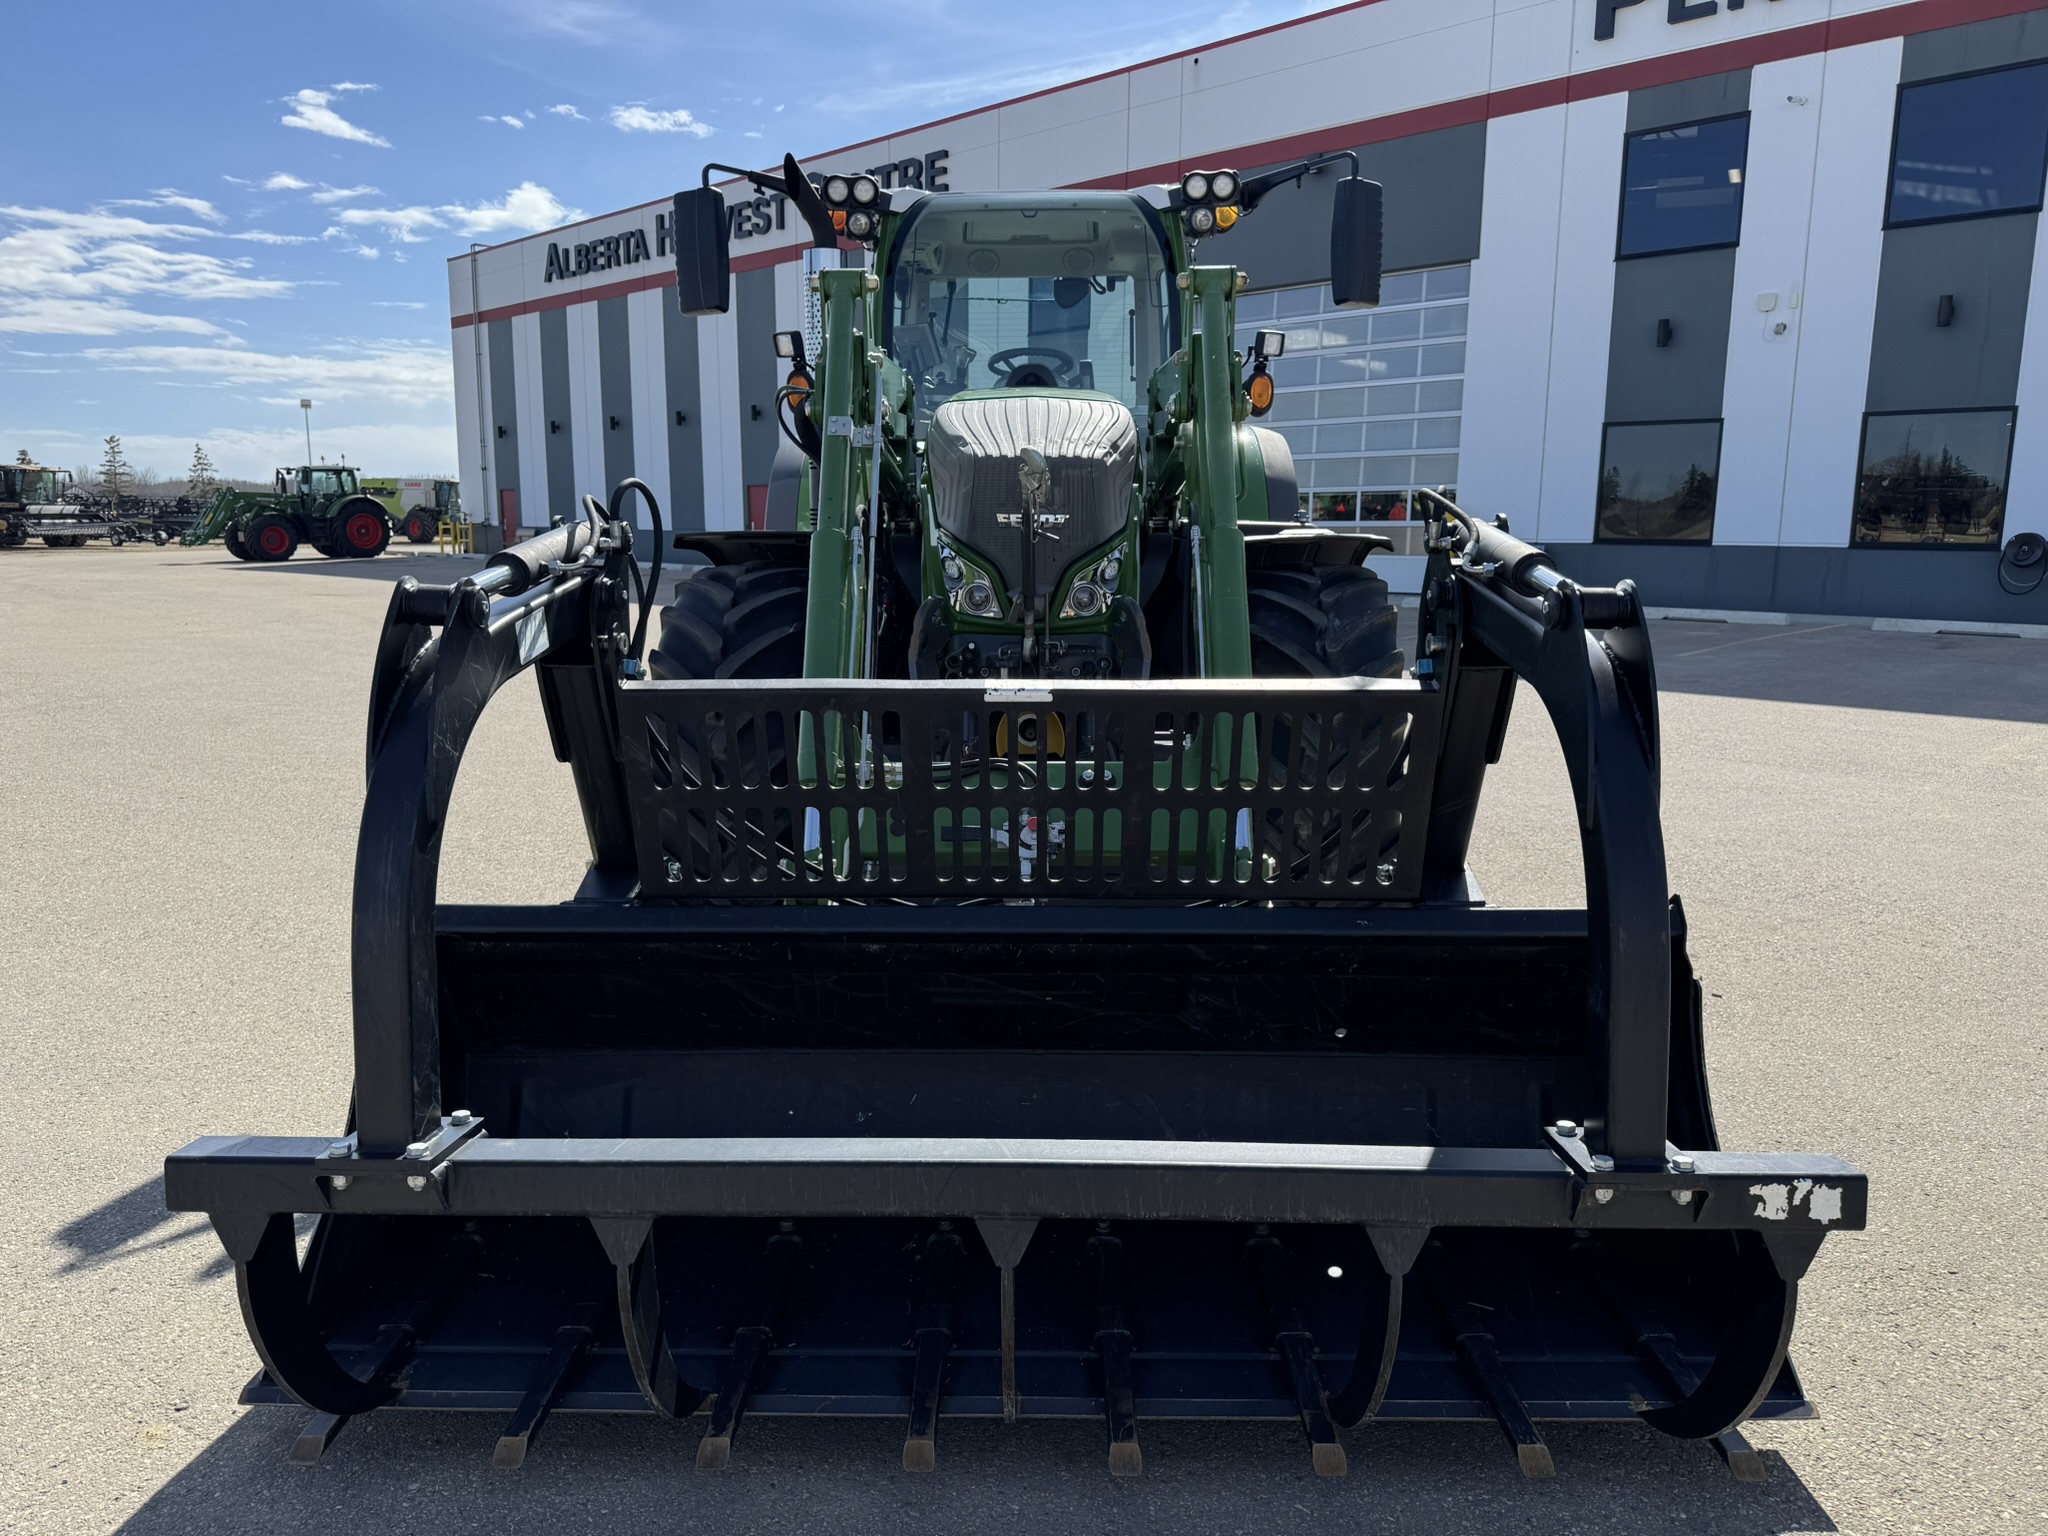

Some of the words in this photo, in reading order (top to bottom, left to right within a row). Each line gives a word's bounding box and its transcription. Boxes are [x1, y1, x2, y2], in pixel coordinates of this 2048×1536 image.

[544, 229, 651, 283] ALBERTA
[807, 149, 949, 193] TRE
[996, 513, 1069, 527] FEDT
